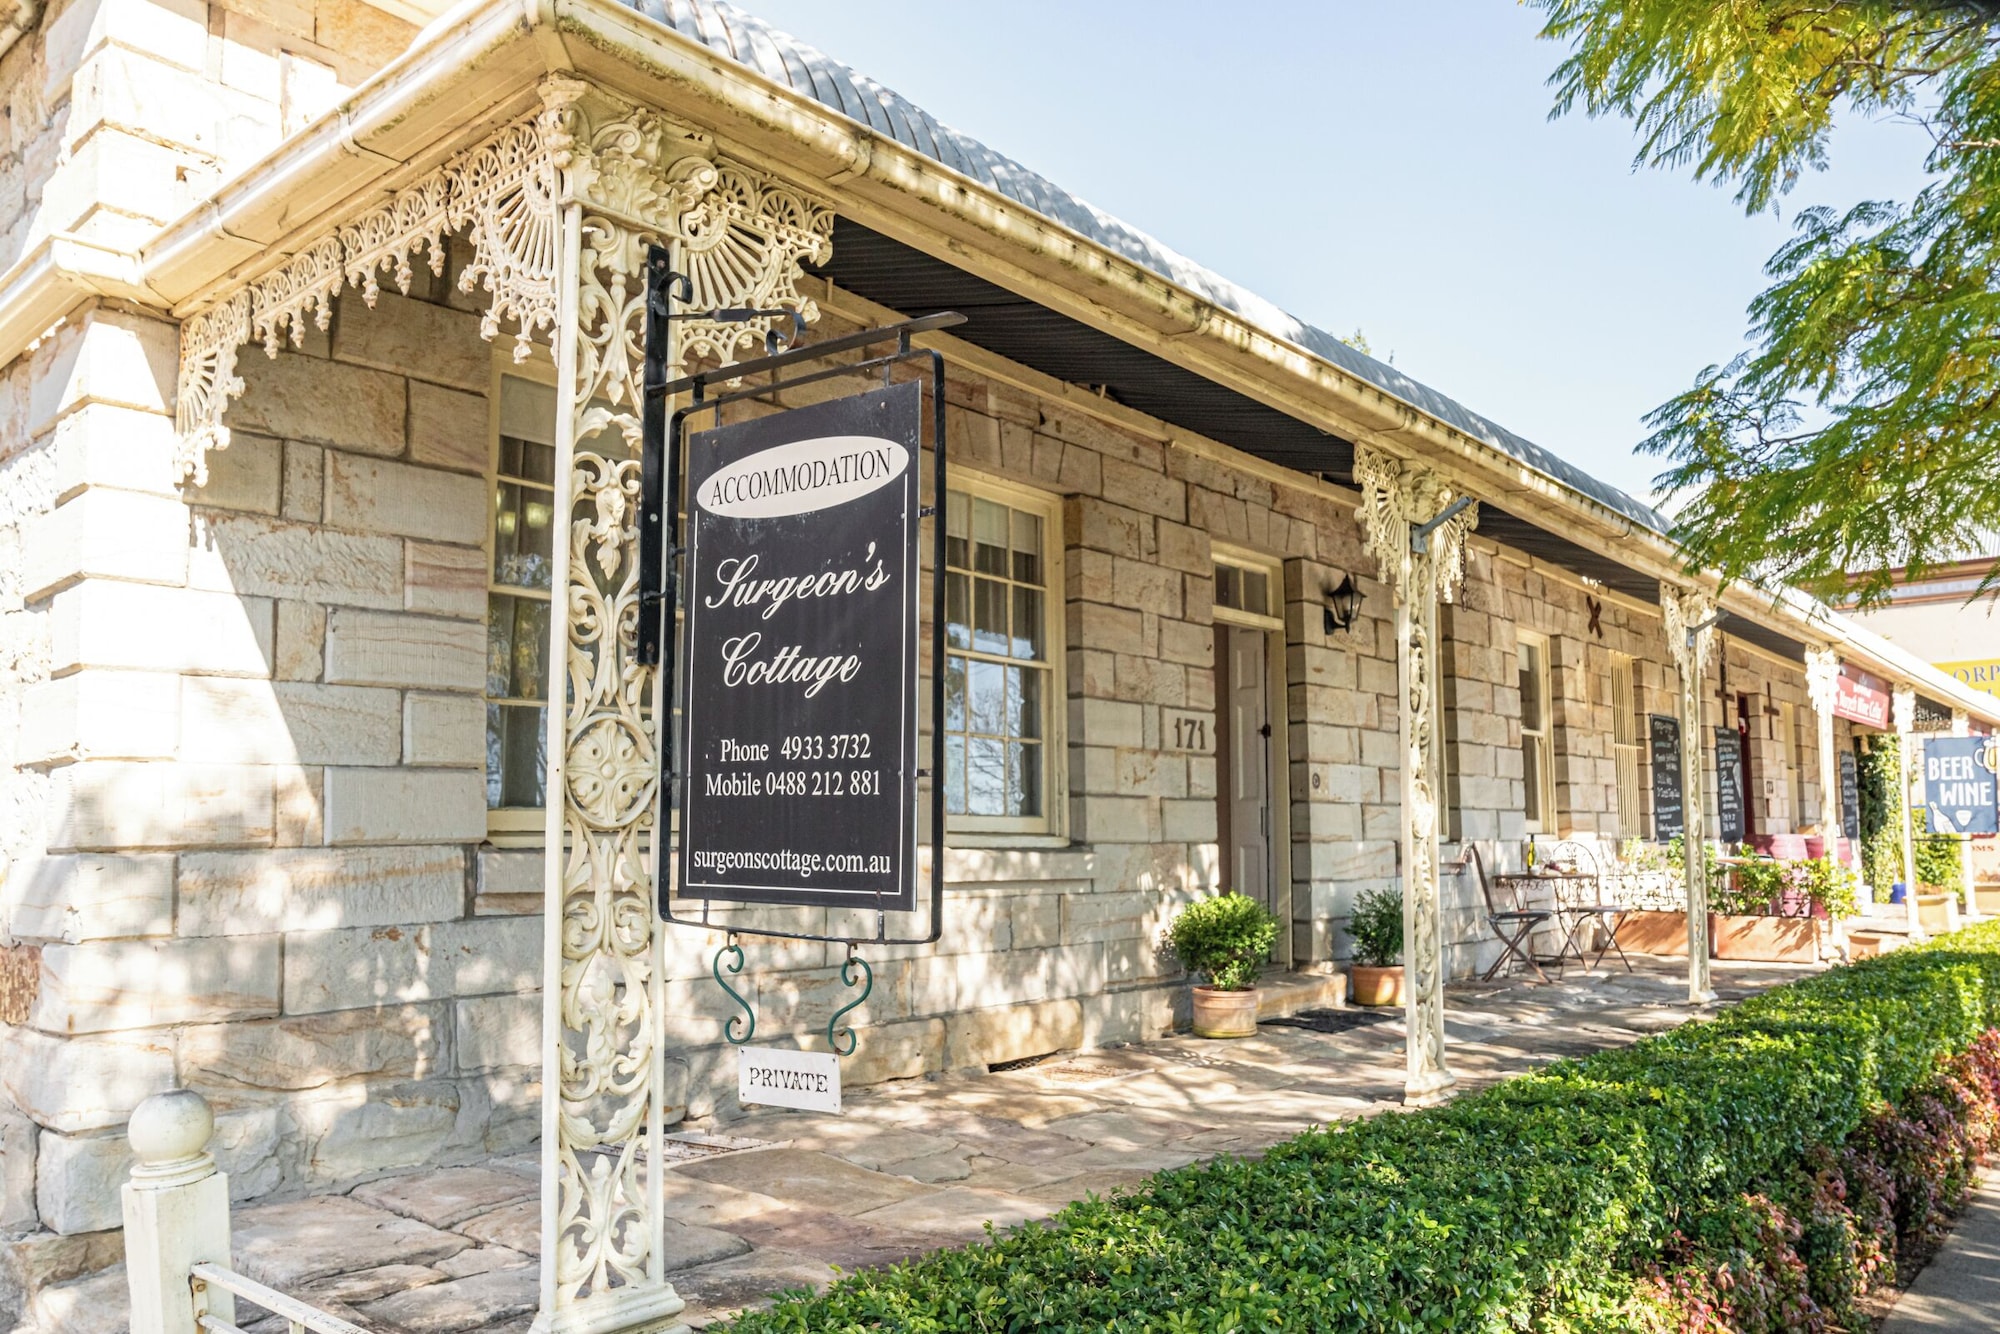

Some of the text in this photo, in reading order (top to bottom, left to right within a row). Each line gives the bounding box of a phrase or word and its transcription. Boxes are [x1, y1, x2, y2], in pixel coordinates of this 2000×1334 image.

[710, 447, 892, 507] ACCOMMODATION
[705, 541, 891, 620] Surgeon's
[721, 631, 862, 699] Cottage
[720, 733, 872, 762] Phone 4933 3732
[1174, 717, 1207, 750] 171
[1927, 756, 1975, 781] BEER
[705, 770, 881, 797] Mobile 0488 212 881
[1940, 782, 1993, 807] WINE
[694, 849, 892, 877] surgeonscottage.com.au
[749, 1067, 829, 1094] PRIVATE
